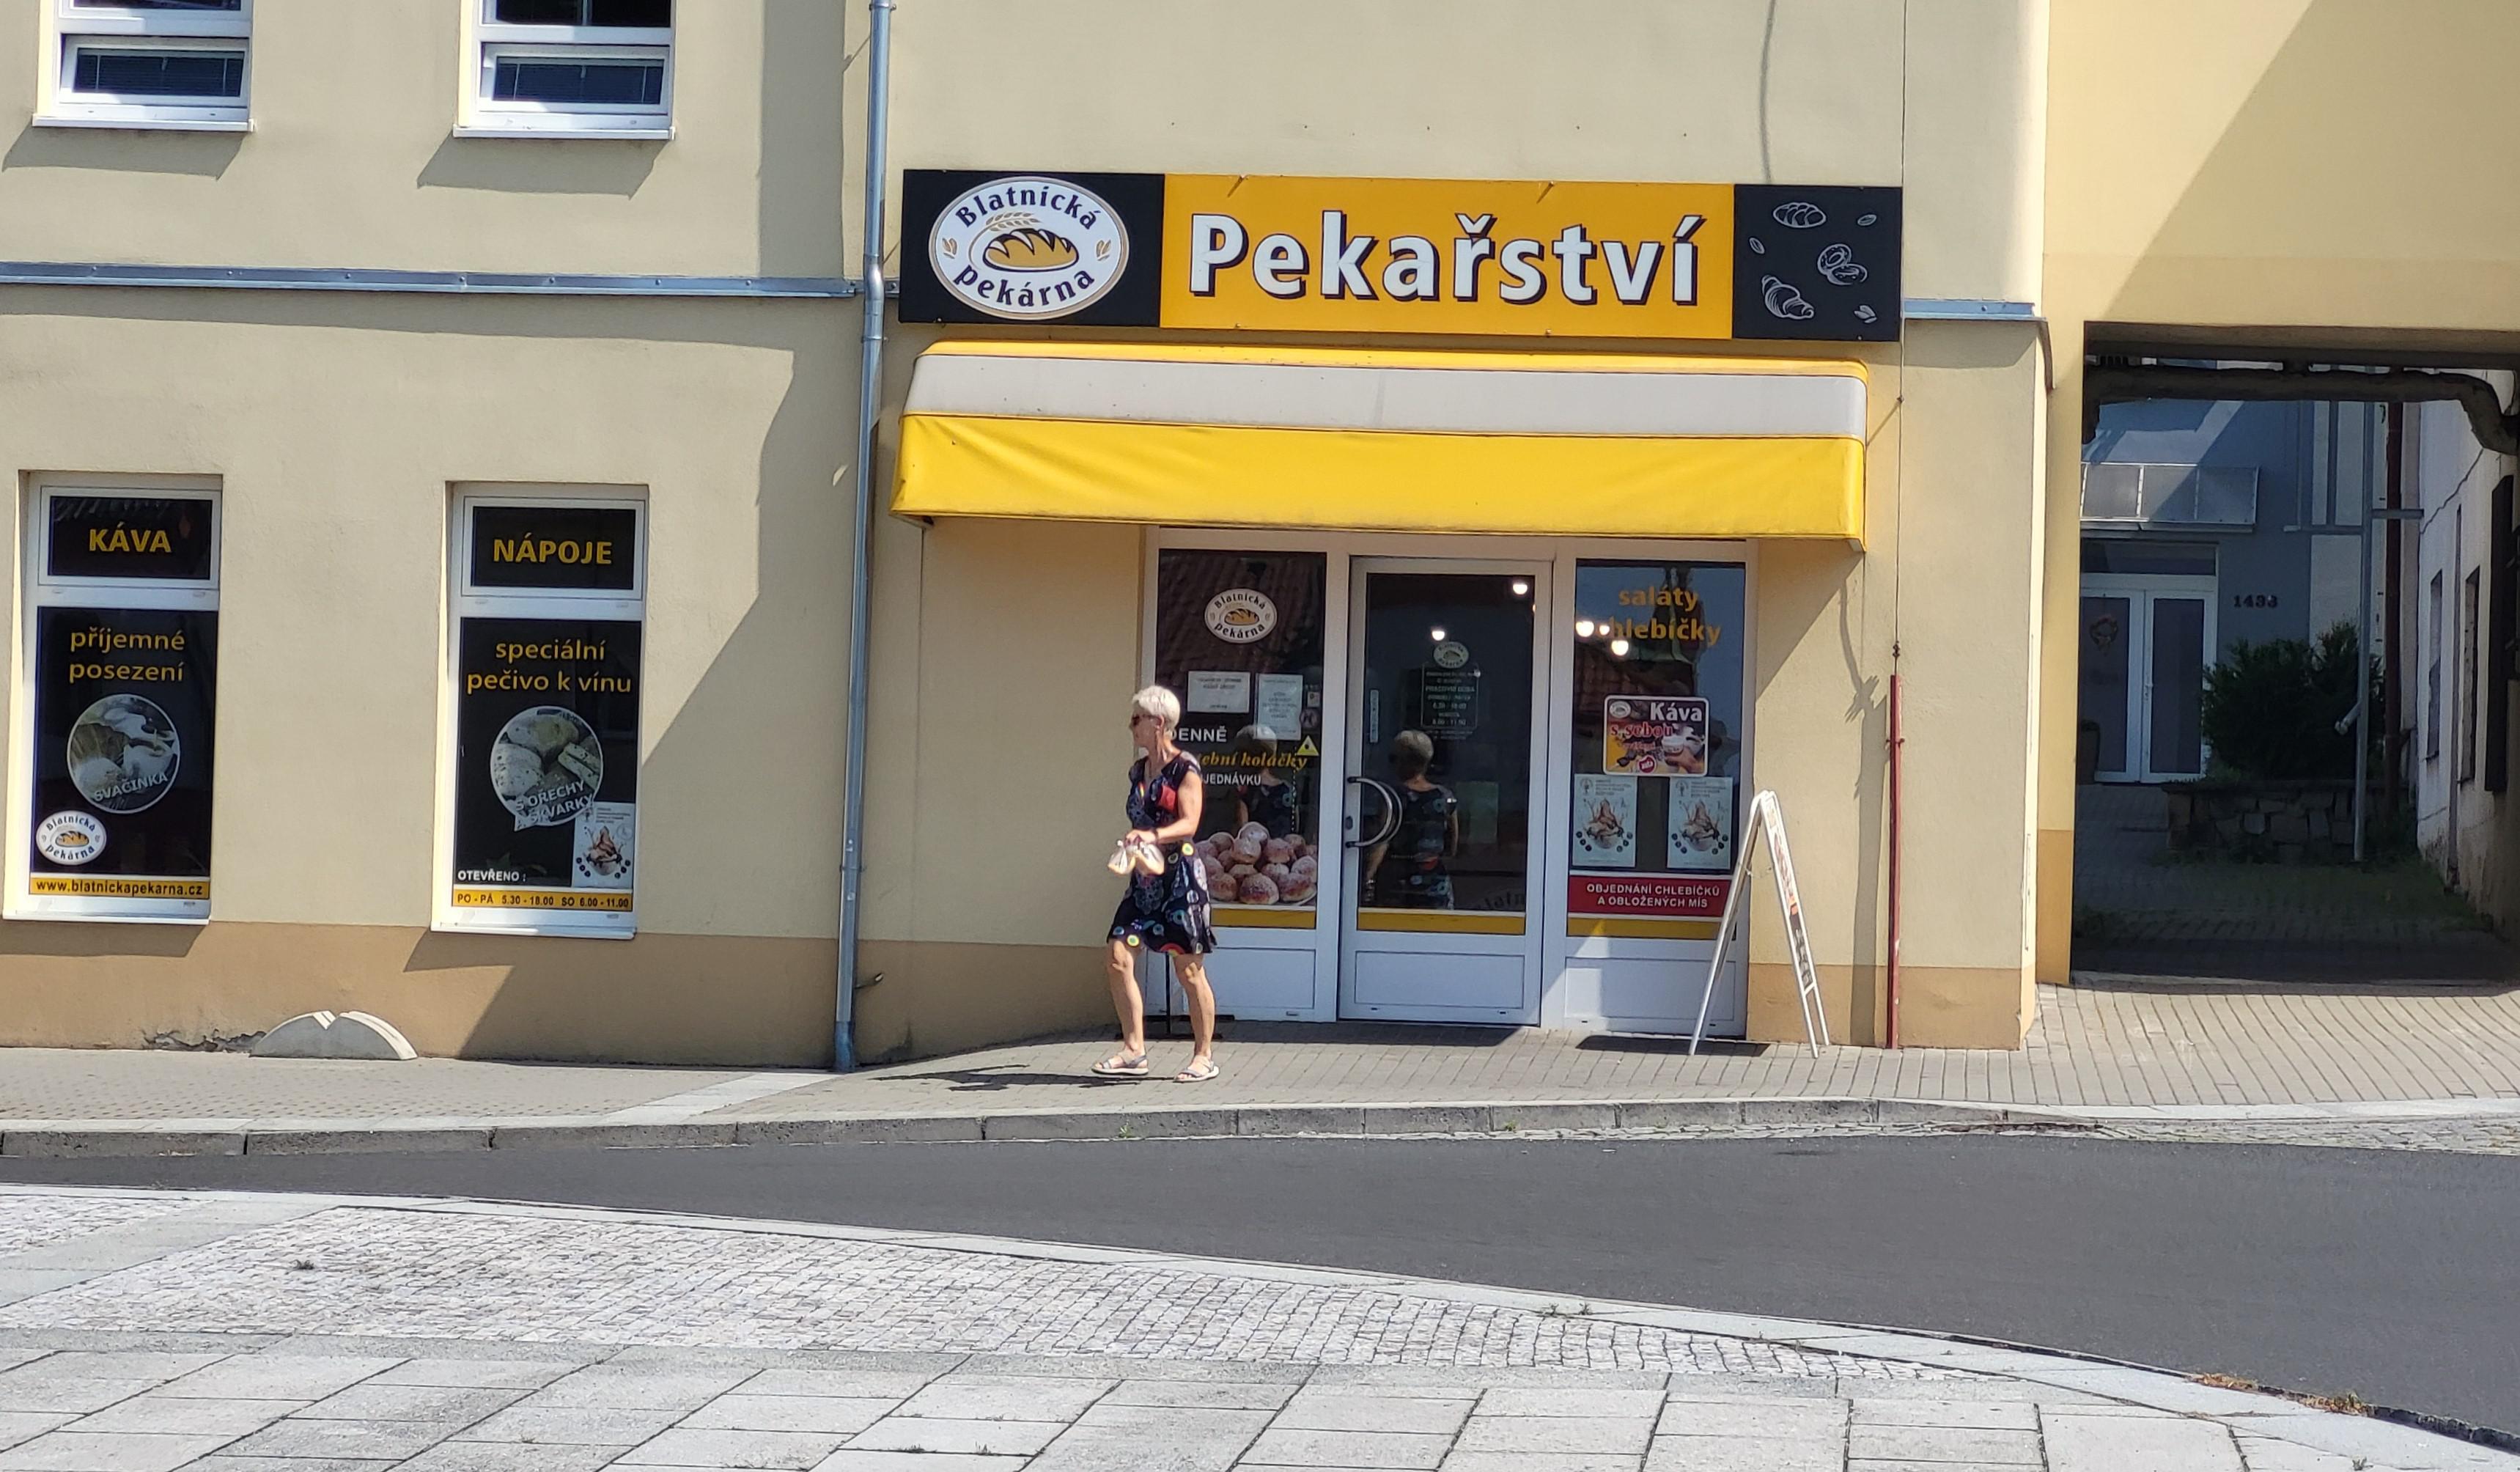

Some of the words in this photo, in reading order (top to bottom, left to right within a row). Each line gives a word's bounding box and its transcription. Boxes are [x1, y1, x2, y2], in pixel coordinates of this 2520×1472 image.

[955, 185, 1101, 232] Blatnická
[1189, 209, 1706, 306] Pekařství
[954, 262, 1095, 308] pekárna
[89, 521, 172, 553] KÁVA
[493, 532, 613, 564] NÁPOJE
[1214, 592, 1266, 609] Blatnická
[1618, 584, 1699, 611] saláty
[70, 627, 185, 653] příjemné
[1214, 623, 1265, 639] pekárna
[1608, 616, 1721, 646] hlebíčky
[495, 639, 607, 664] speciální
[69, 661, 184, 683] posezení
[467, 669, 549, 694] pečivo
[558, 671, 570, 691] k
[578, 671, 631, 693] vínu
[1650, 702, 1703, 721] Káva
[1626, 721, 1673, 737] sebou
[1198, 751, 1238, 767] ební
[1241, 751, 1308, 772] koláčky
[93, 771, 168, 801] SVAČINKA
[1203, 771, 1261, 786] JEDNÁVKU
[528, 779, 585, 806] OŘECHY
[46, 815, 95, 831] Blatnická
[45, 844, 95, 860] pekárna
[457, 868, 520, 881] OTEVŘENO
[36, 879, 203, 897] www.blatnickapekarna.cz
[1587, 883, 1651, 894] OBJEDNÁNÍ
[1655, 885, 1720, 896] CHLEBÍČKŮ
[457, 895, 471, 904] PO
[480, 894, 494, 905] PÁ
[561, 897, 575, 906] SO
[607, 898, 629, 908] 11.00
[1597, 896, 1605, 905] A
[1608, 896, 1685, 908] OBLOŽENÝCH
[1688, 897, 1708, 908] MÍS
